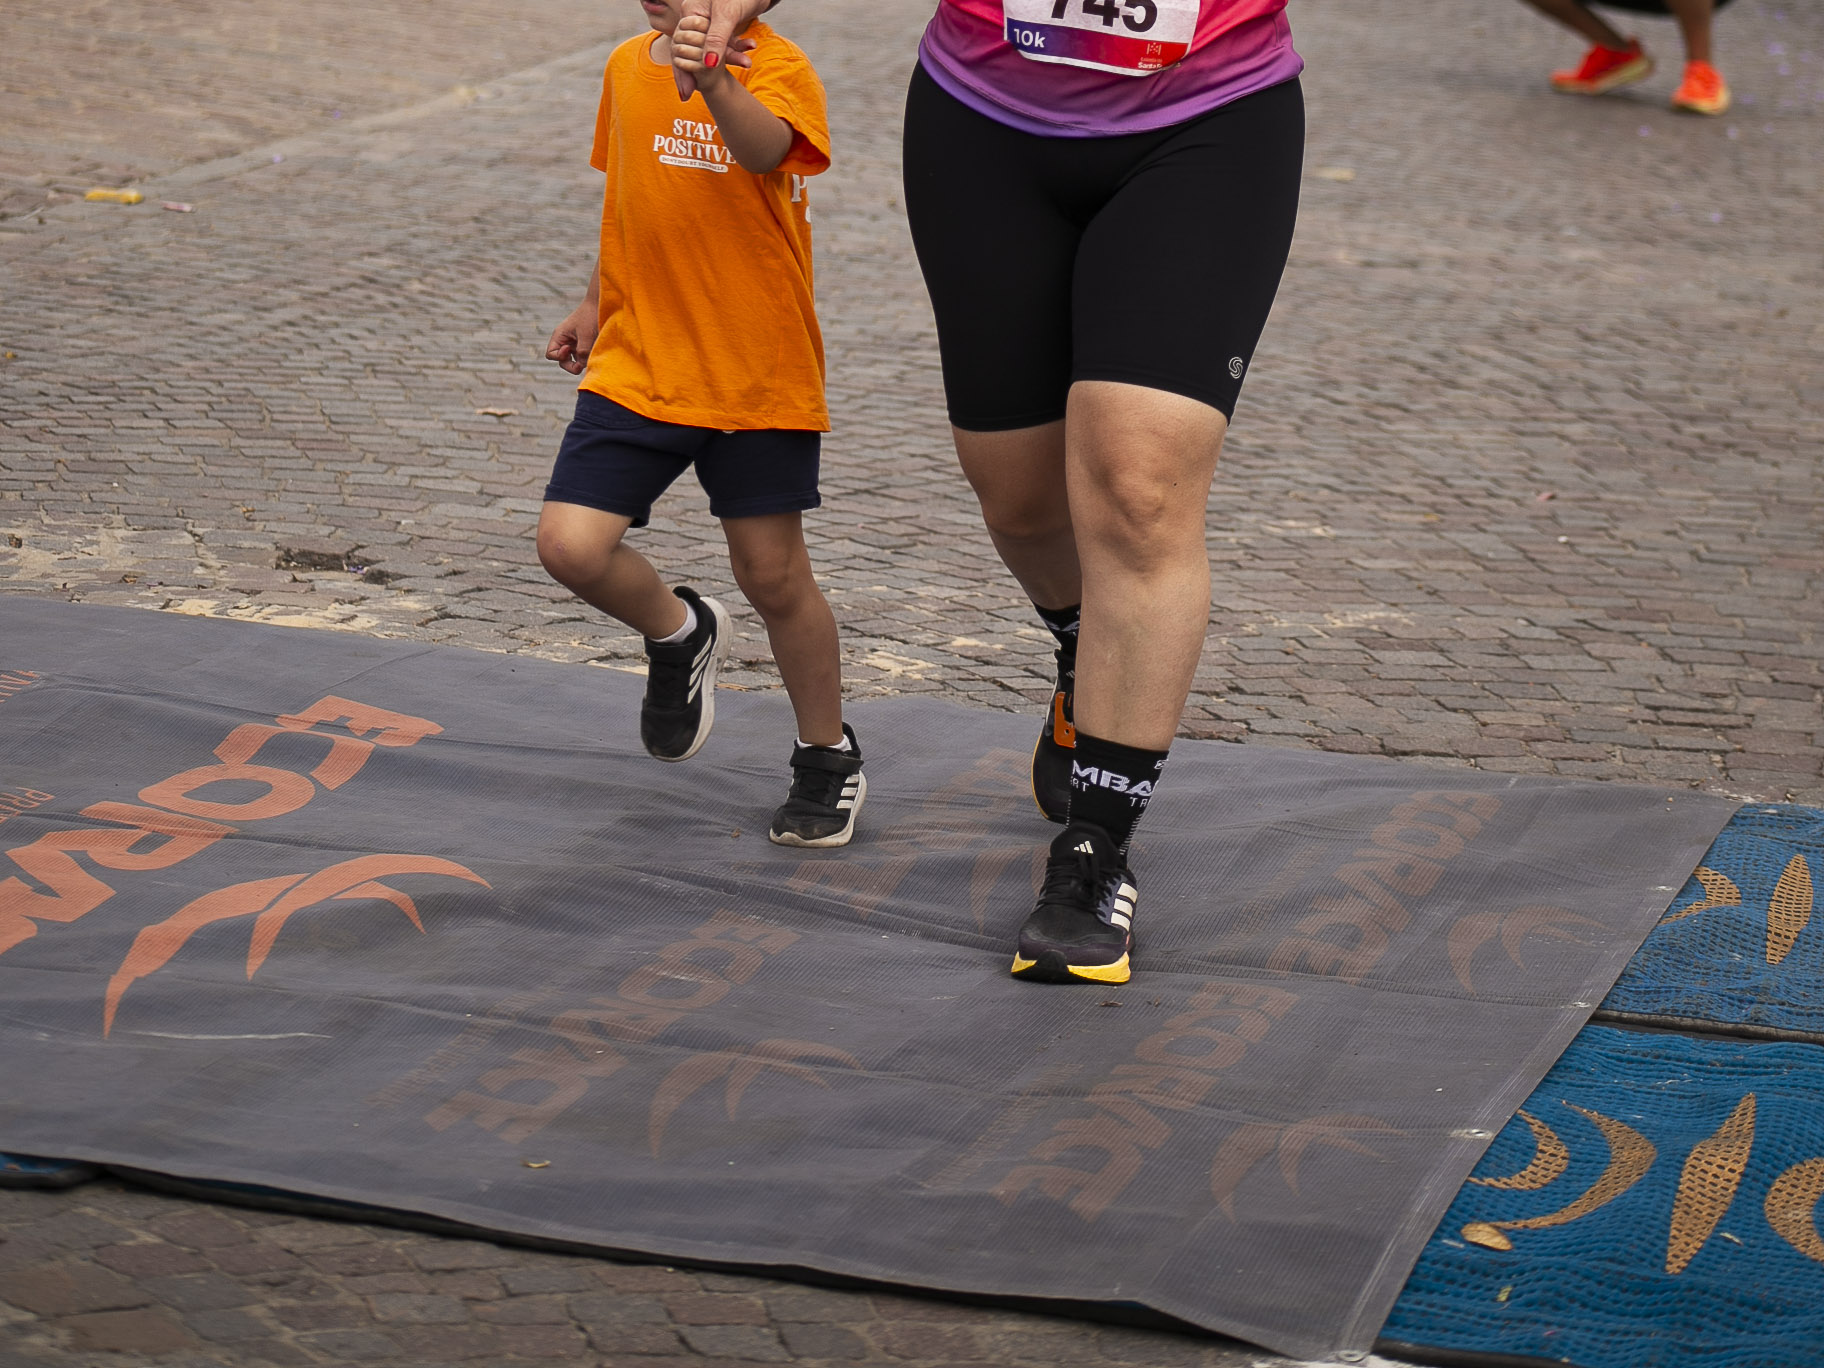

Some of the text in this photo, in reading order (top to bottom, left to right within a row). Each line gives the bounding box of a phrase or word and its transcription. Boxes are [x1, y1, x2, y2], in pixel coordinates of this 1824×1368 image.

[1014, 28, 1046, 49] 10k
[673, 118, 718, 142] STAY
[1072, 759, 1160, 797] MBA
